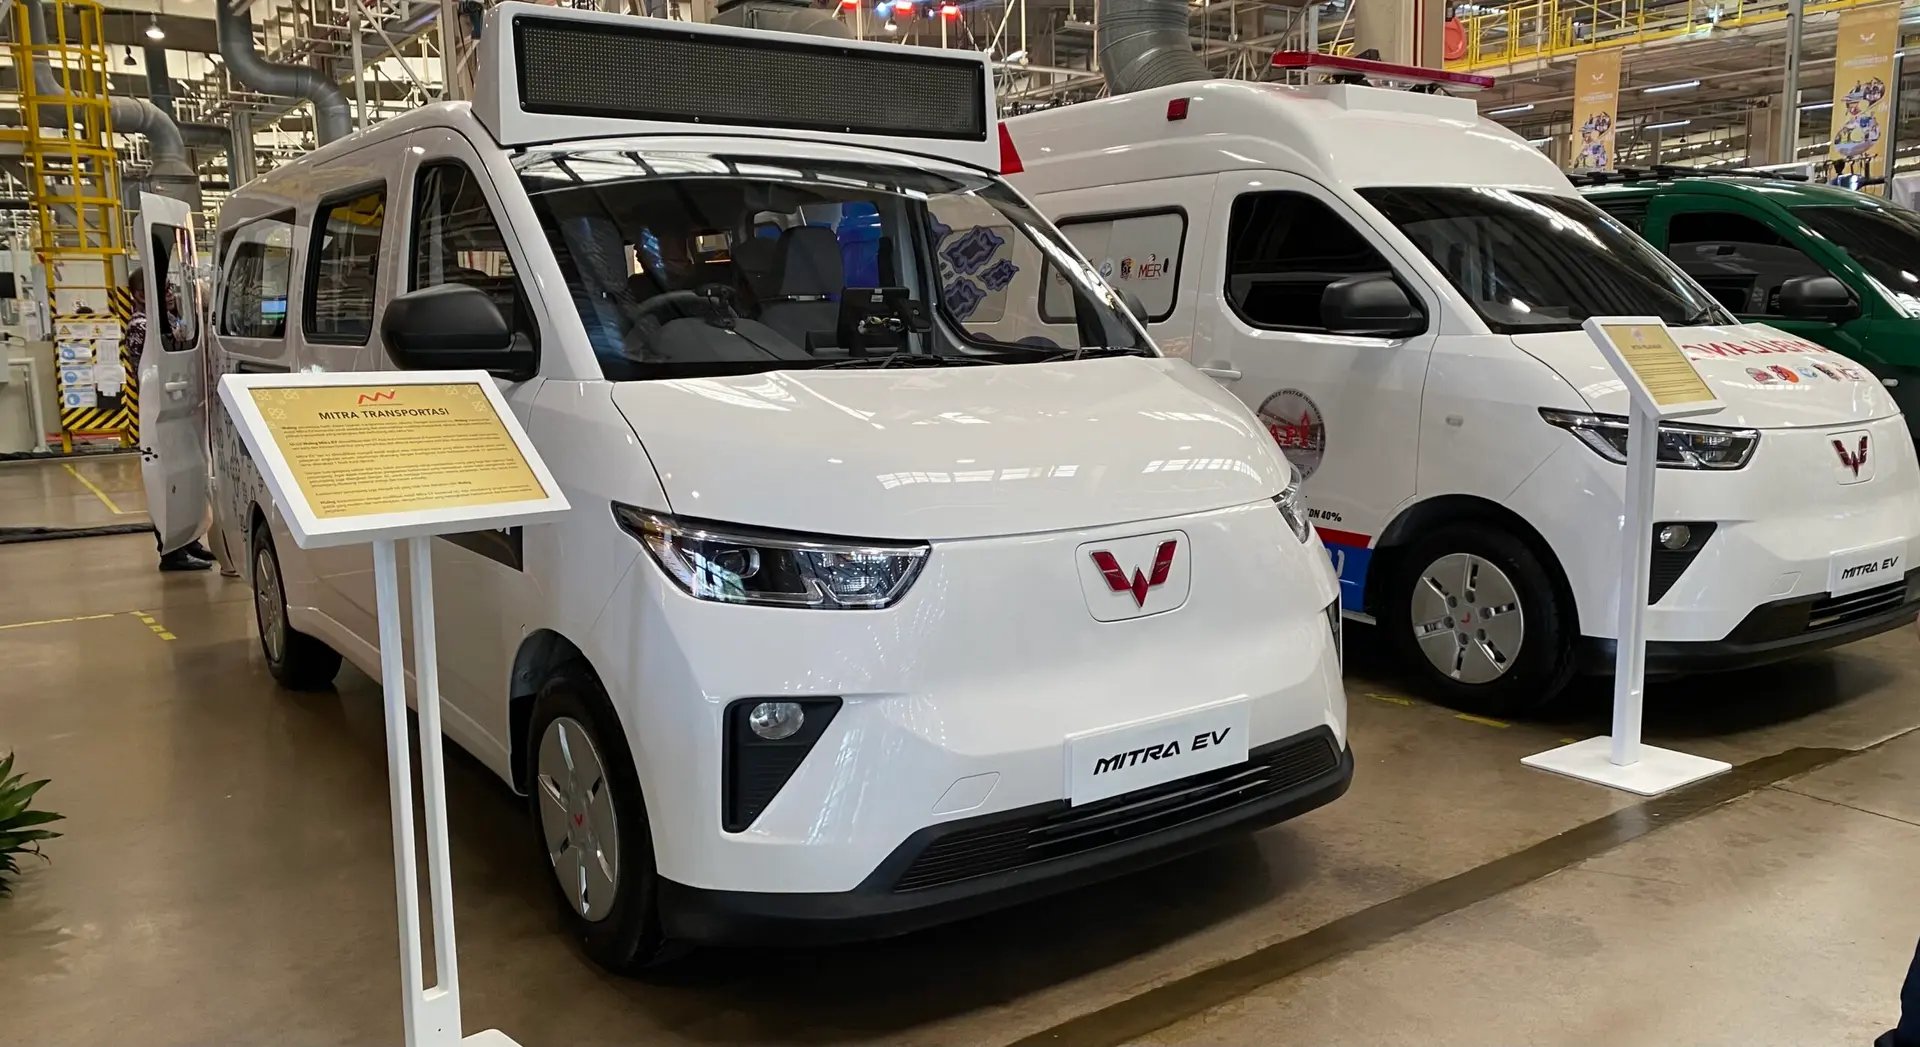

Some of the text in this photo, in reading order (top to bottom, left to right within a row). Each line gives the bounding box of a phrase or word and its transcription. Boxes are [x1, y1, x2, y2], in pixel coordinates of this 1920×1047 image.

[1138, 263, 1162, 278] MER
[318, 408, 450, 420] MITRA TRANSPORTASI
[1307, 507, 1343, 522] DN 40%
[1841, 556, 1899, 580] MITRA EV
[1093, 727, 1231, 775] MITRA EV
